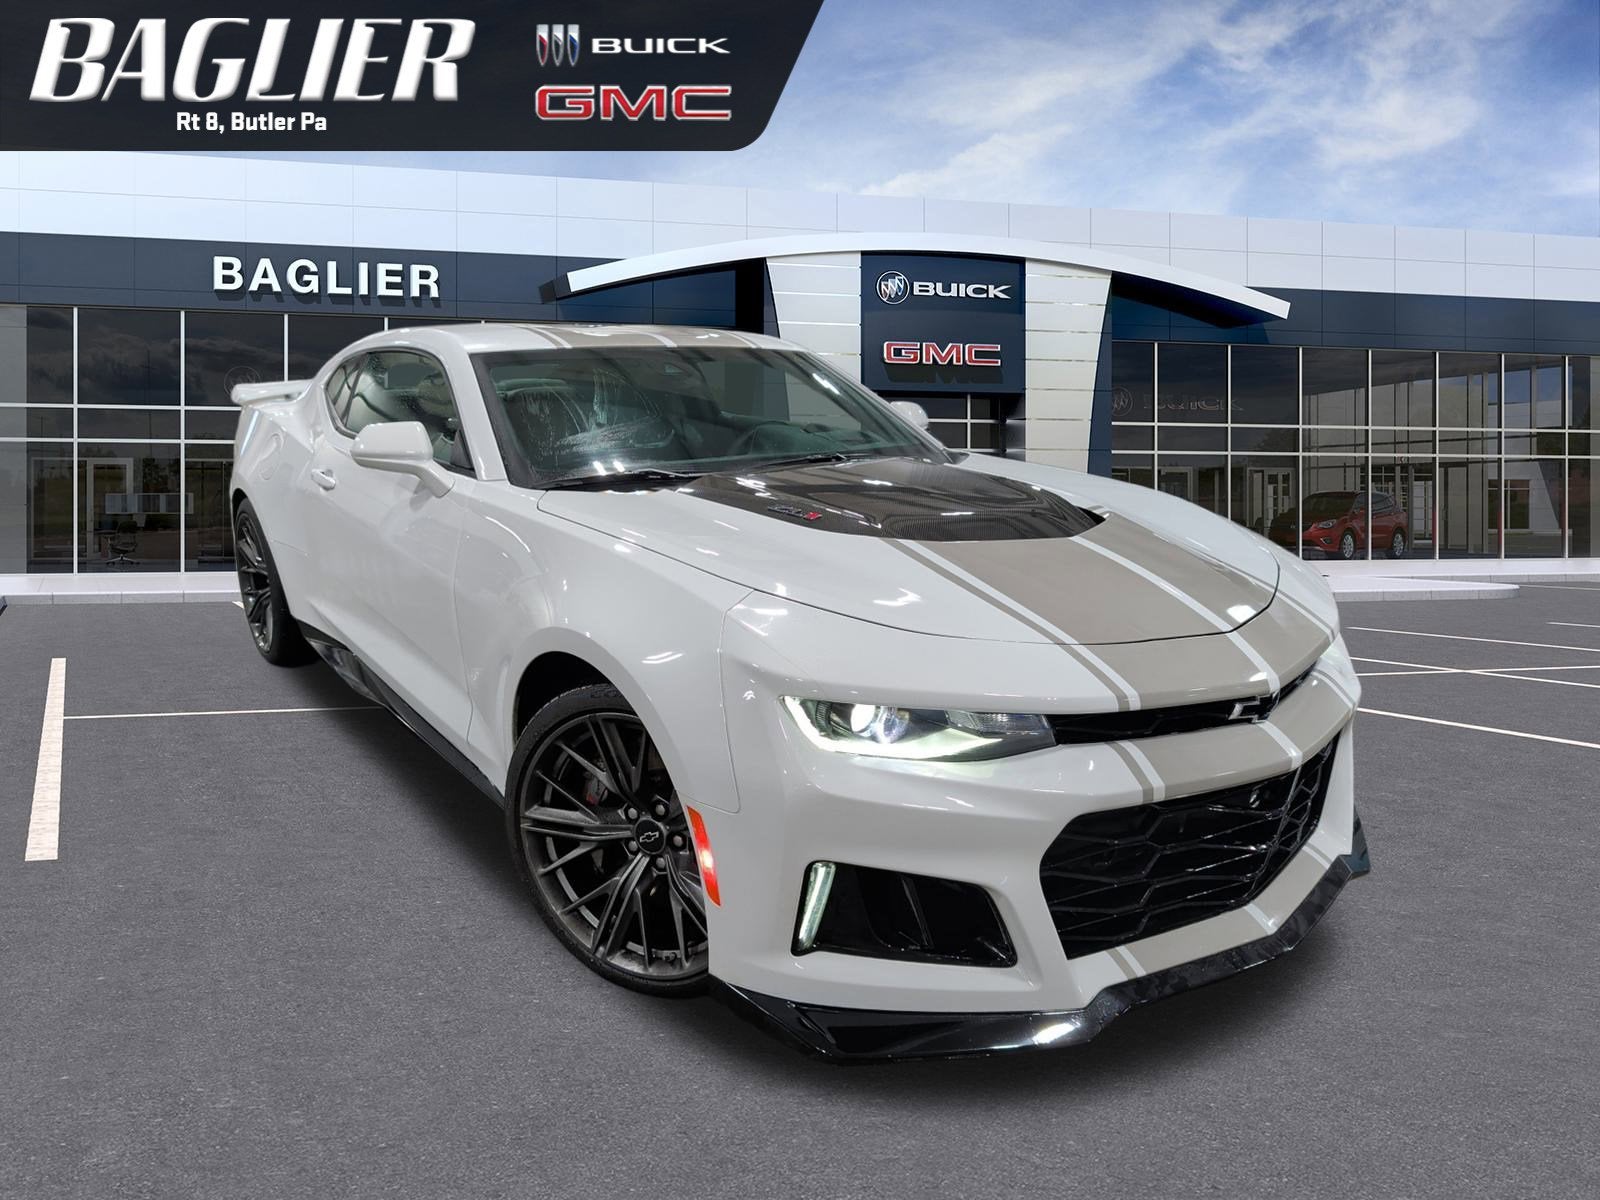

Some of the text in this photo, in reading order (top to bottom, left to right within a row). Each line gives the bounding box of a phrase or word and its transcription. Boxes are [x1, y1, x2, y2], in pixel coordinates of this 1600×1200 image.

[213, 255, 440, 299] BAGLIER
[912, 281, 1012, 299] BUICK
[883, 341, 1001, 366] GMC
